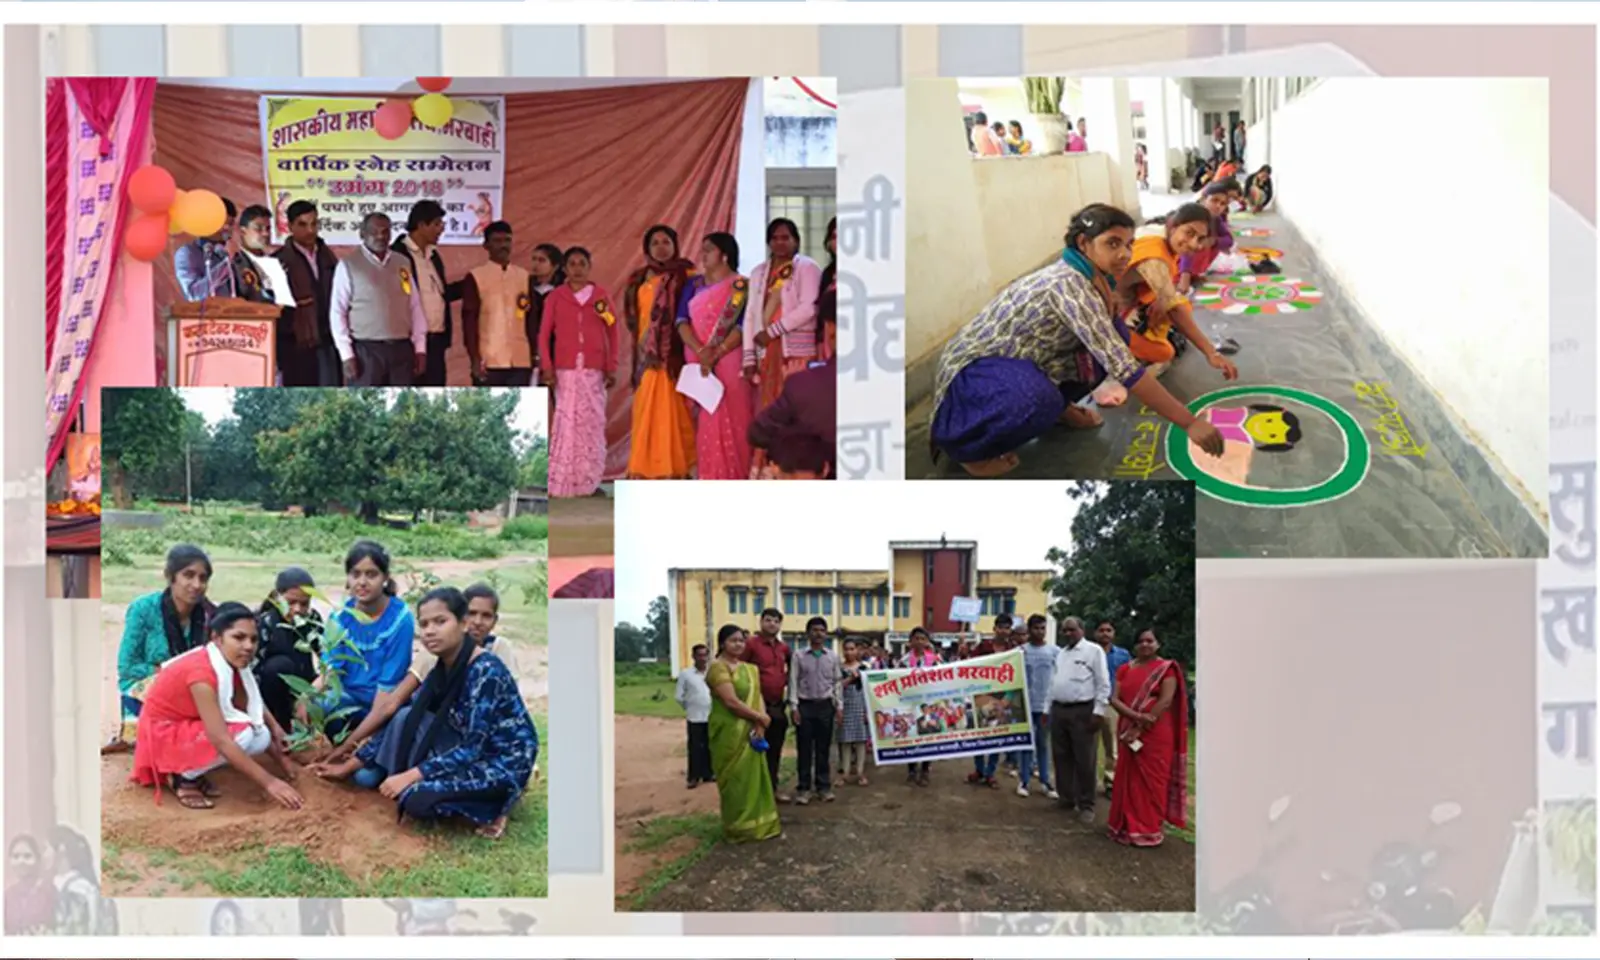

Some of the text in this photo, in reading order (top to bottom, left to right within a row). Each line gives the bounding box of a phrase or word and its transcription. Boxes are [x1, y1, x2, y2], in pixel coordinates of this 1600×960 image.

[272, 108, 342, 149] शासकीय
[276, 154, 350, 171] वार्षिक
[405, 154, 493, 172] सम्मेलन
[957, 661, 1015, 685] मरवाही
